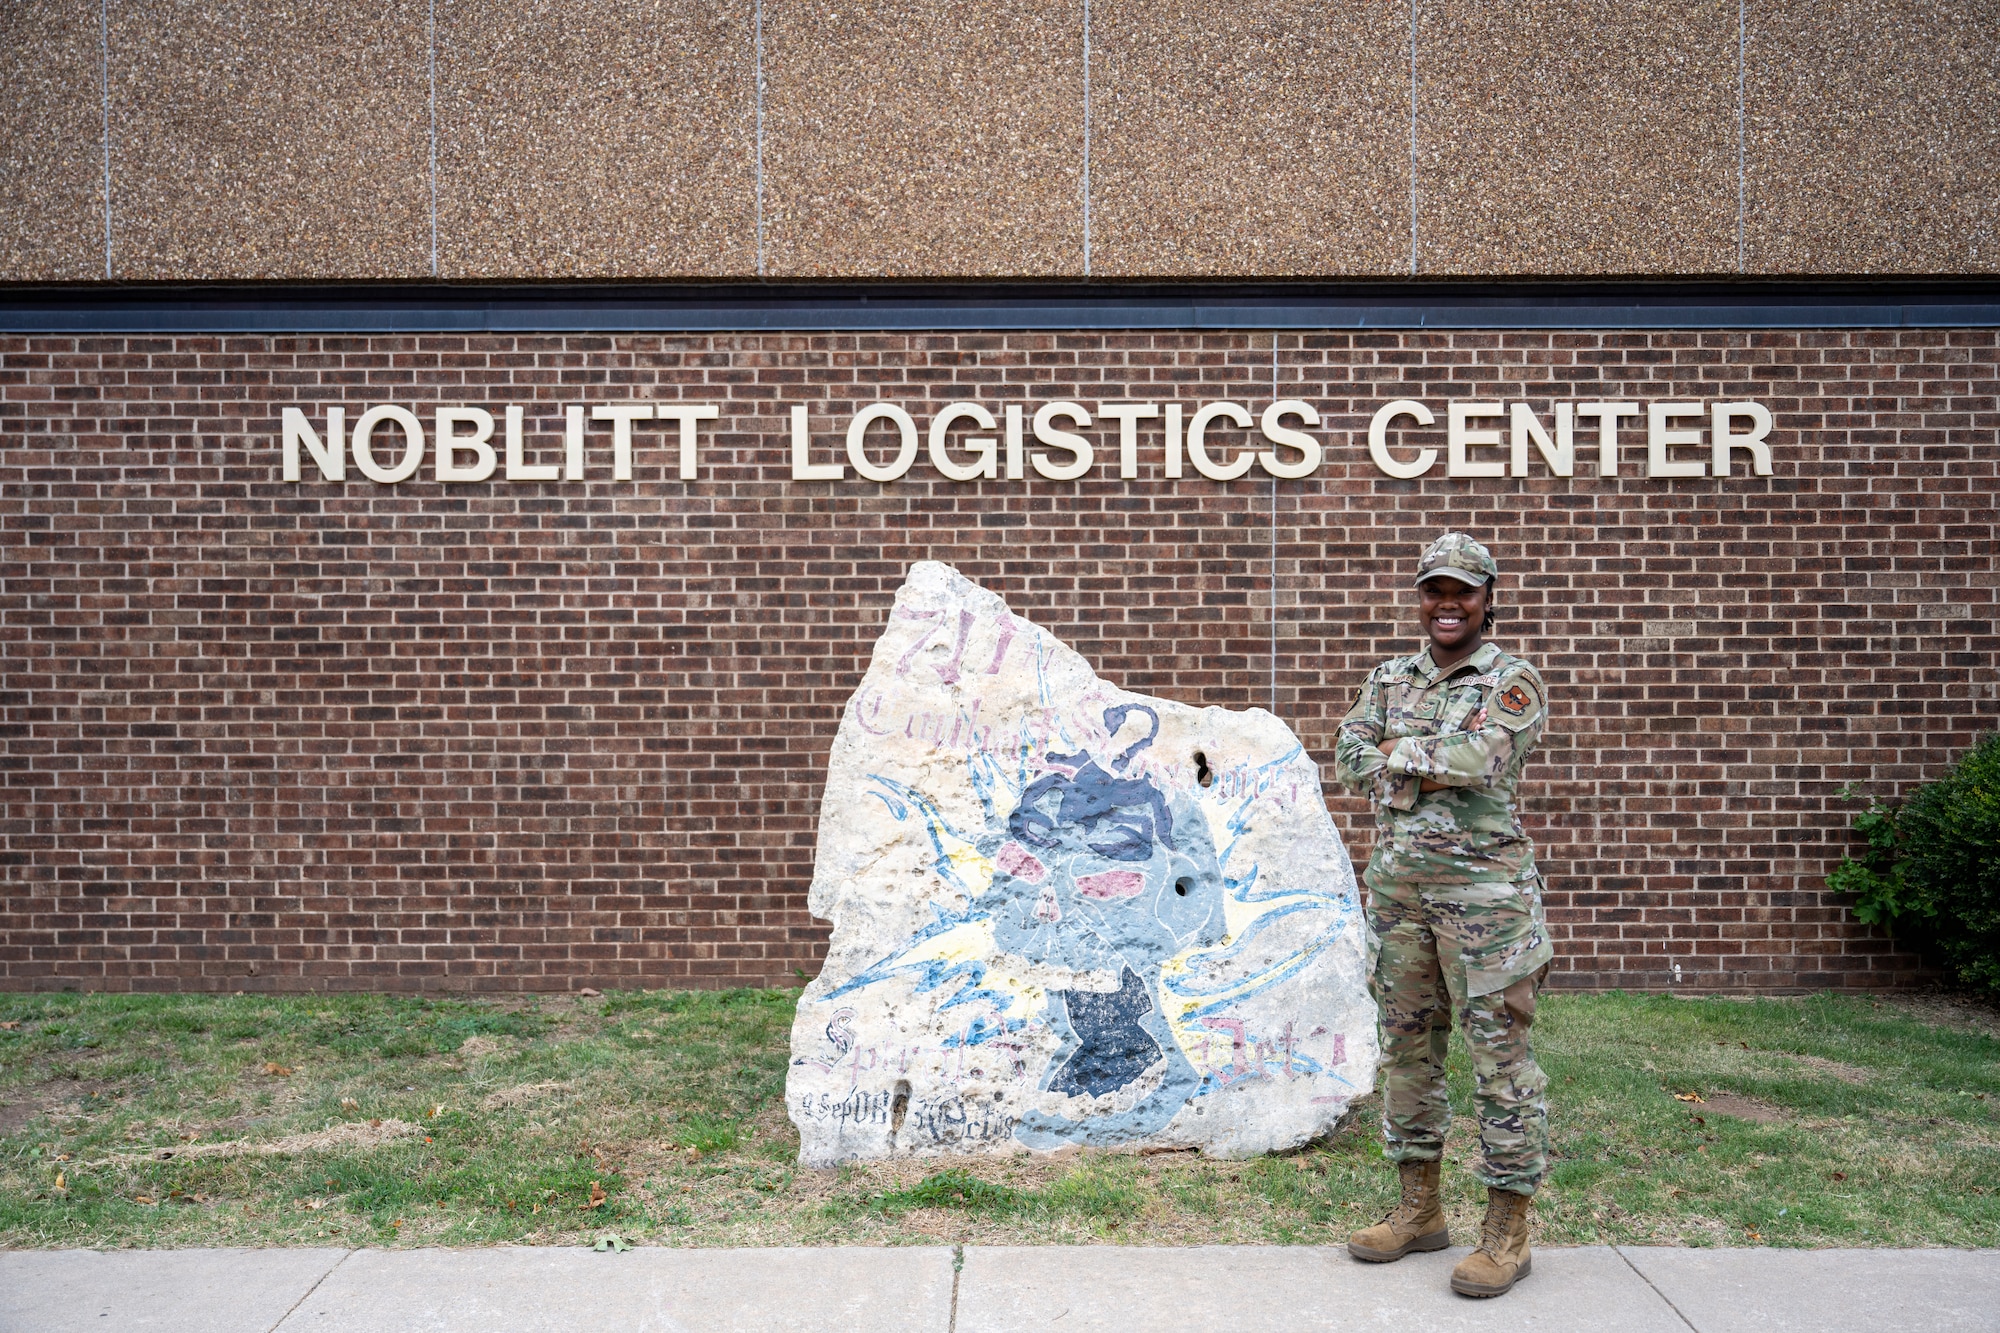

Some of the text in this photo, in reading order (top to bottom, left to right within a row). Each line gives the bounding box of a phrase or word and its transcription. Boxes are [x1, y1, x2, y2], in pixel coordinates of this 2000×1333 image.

[281, 399, 1775, 484] NOBLITT LOGISTICS CENTER
[1462, 676, 1474, 685] AIR
